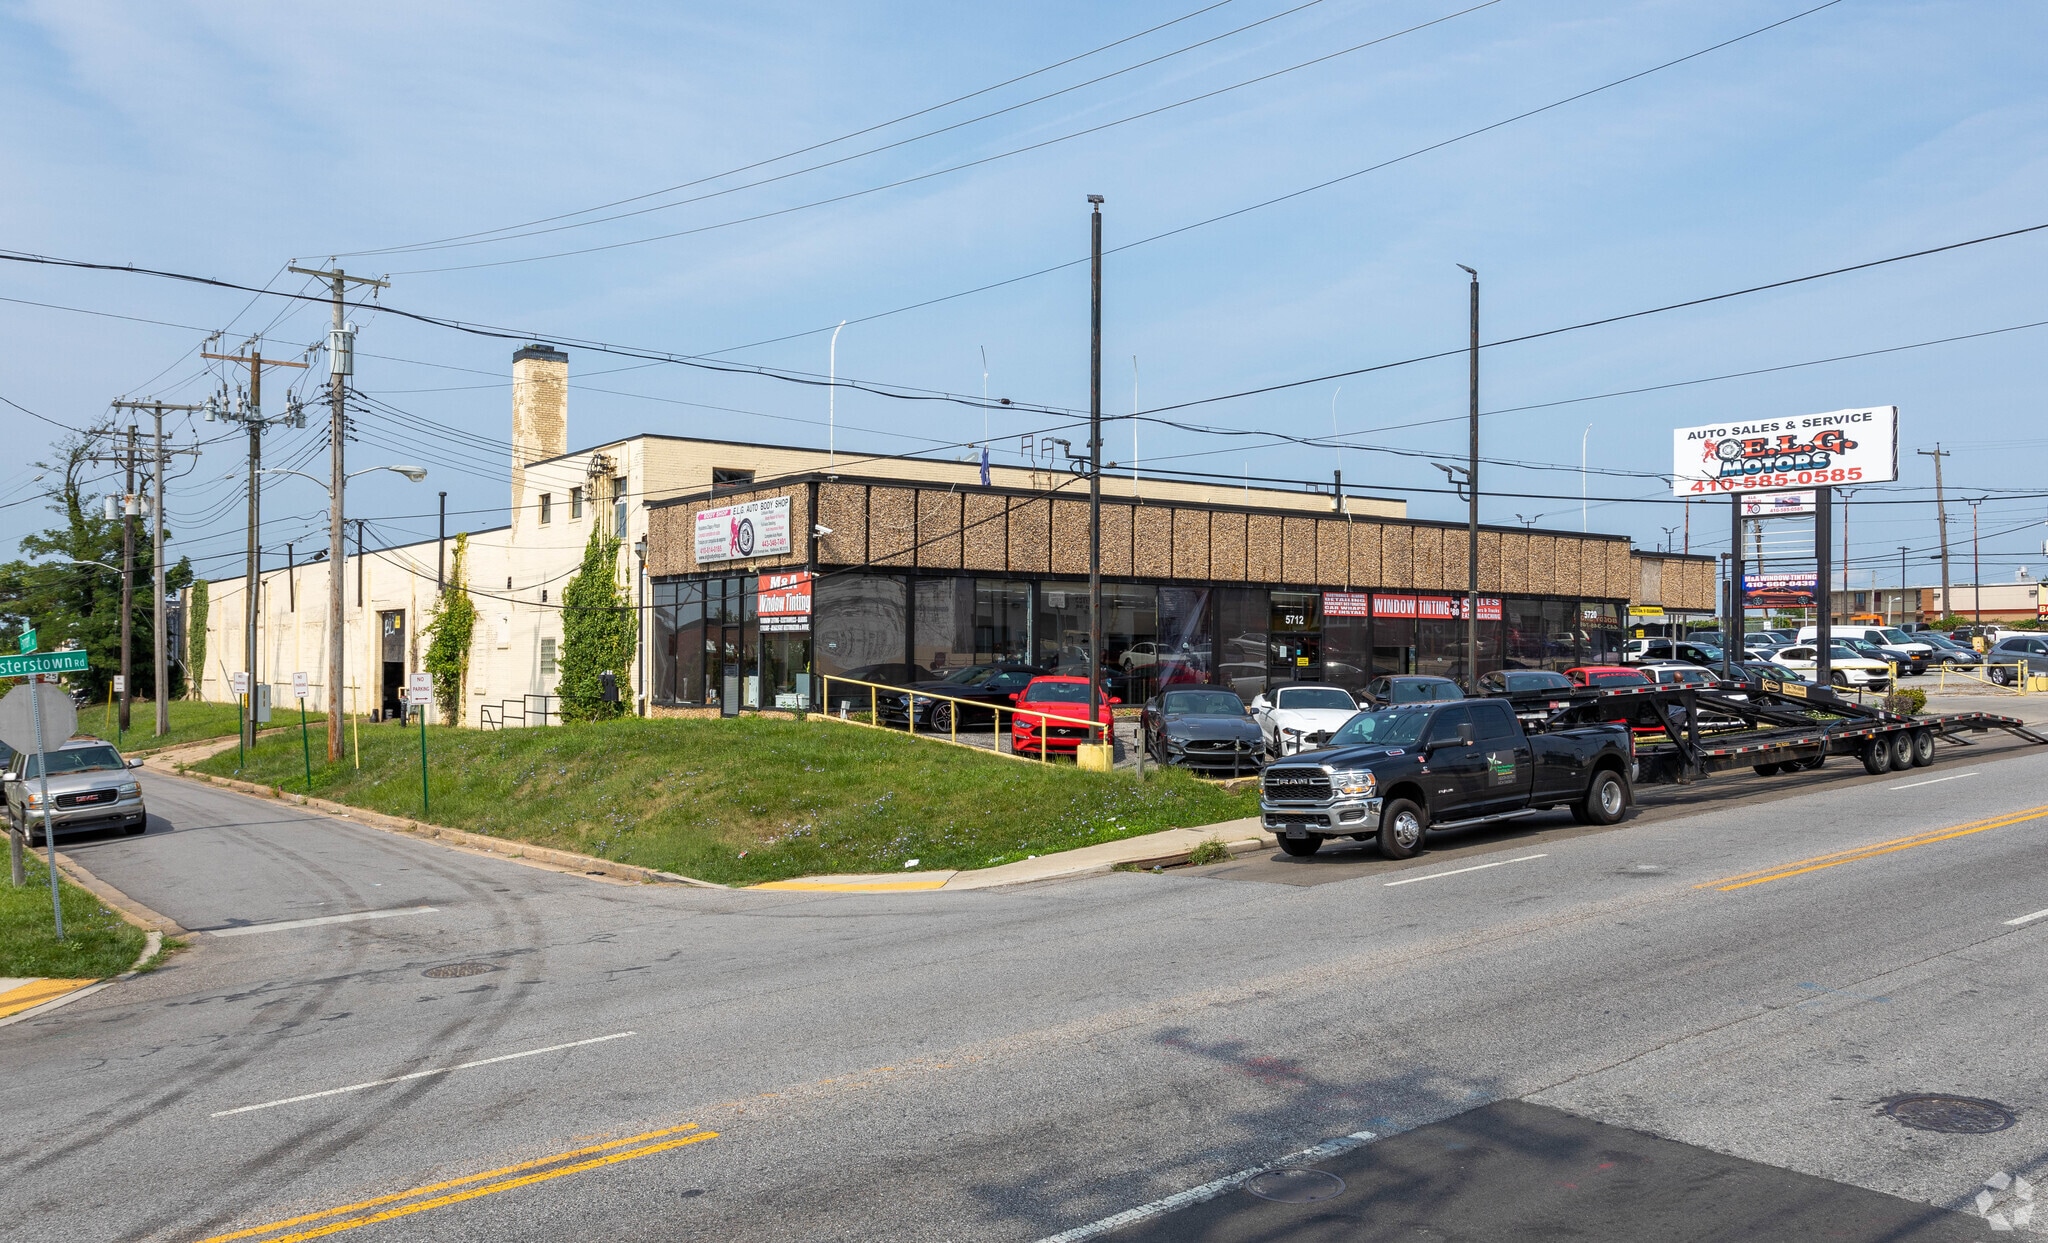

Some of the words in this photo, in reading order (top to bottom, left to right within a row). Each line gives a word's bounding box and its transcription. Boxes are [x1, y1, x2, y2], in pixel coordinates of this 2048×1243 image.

[1687, 428, 1726, 441] AUTO
[1732, 423, 1780, 436] SALES
[1785, 420, 1796, 430] &
[1802, 411, 1873, 428] SERVICE
[1741, 429, 1858, 459] E.L.G.
[1719, 451, 1831, 478] MOTORS
[1690, 467, 1863, 493] 410-585-0585
[746, 503, 759, 513] AUTO
[760, 501, 774, 511] BODY
[774, 498, 789, 508] SHOP
[769, 574, 798, 590] M&A
[1745, 580, 1816, 588] 410-660-0439
[1760, 574, 1790, 582] WINDOW
[1791, 573, 1818, 581] TINTING
[759, 593, 786, 613] Window
[785, 592, 811, 613] Tinting
[1374, 598, 1415, 614] WINDOW
[1418, 600, 1450, 616] TINTING
[1285, 615, 1304, 625] 5712
[1583, 610, 1598, 619] 5720
[0, 657, 73, 674] sterstown
[74, 658, 85, 667] Rd
[45, 672, 57, 680] 25
[75, 794, 99, 803] GMC
